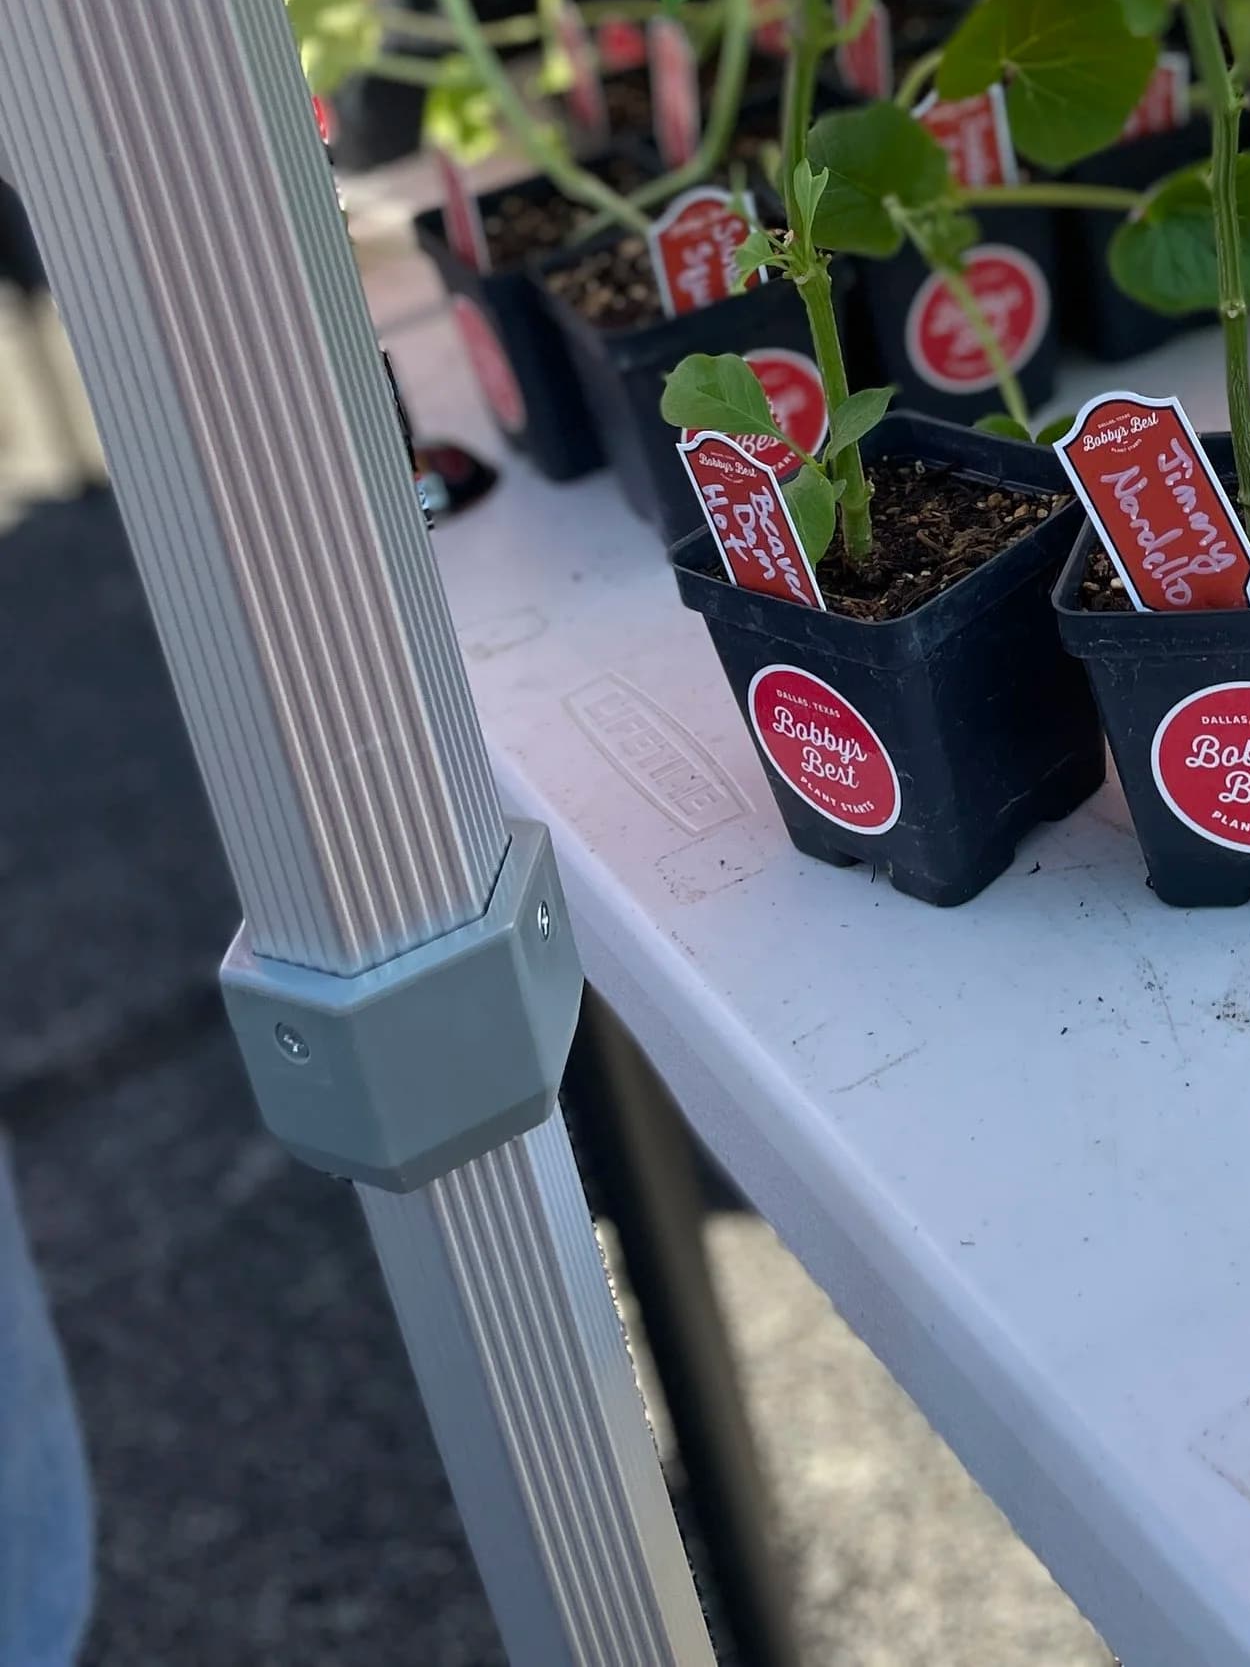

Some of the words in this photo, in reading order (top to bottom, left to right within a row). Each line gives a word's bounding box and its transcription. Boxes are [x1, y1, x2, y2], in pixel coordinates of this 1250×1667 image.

[735, 434, 781, 455] Bes
[1083, 426, 1129, 451] Bobby's
[1130, 412, 1159, 433] Best
[702, 484, 749, 561] Hot
[1158, 438, 1237, 573] Jimmy
[733, 504, 776, 580] Dam
[813, 702, 841, 718] TEXAS
[772, 706, 868, 764] Bobby's
[801, 746, 859, 789] Best
[801, 776, 837, 807] PLANT
[841, 800, 875, 814] STARTS
